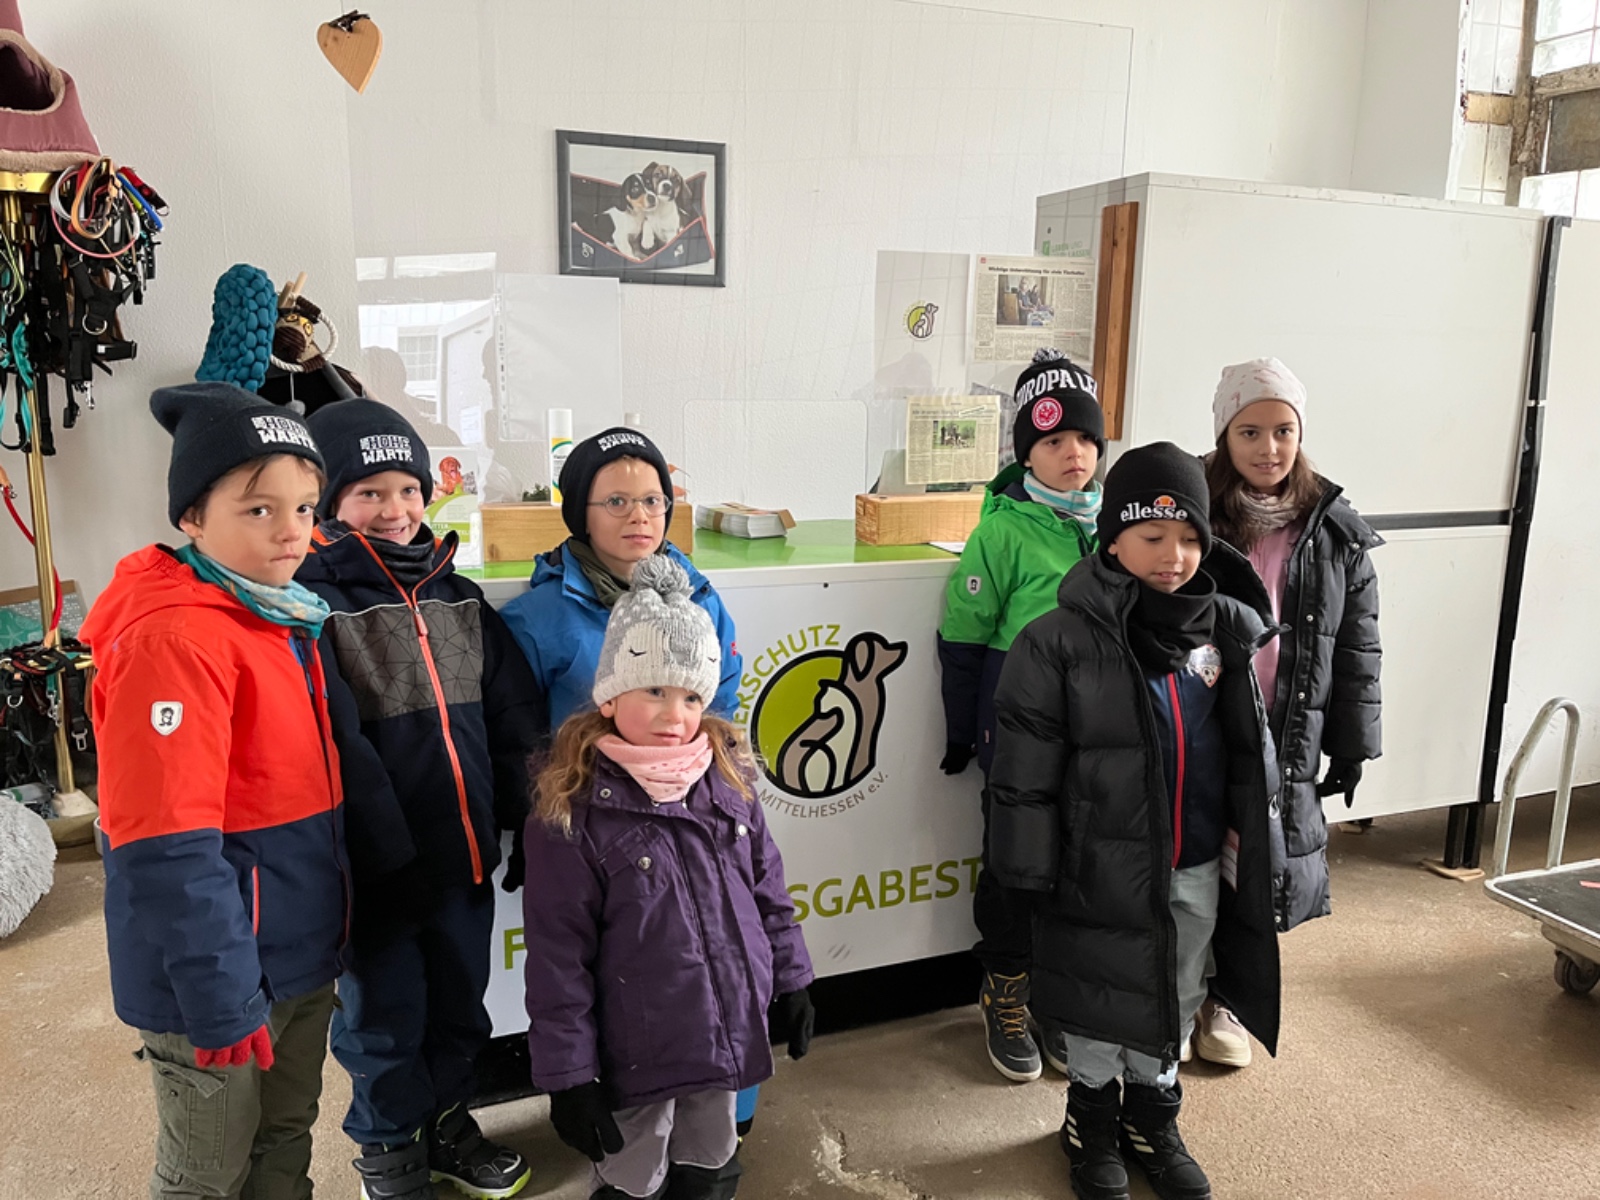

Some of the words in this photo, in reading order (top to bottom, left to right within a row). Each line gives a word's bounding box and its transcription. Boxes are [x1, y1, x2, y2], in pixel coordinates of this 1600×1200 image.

[1120, 502, 1188, 522] ellesse
[733, 624, 840, 732] ERSCHUTZ
[758, 789, 865, 818] MITTELHESSEN
[867, 771, 889, 793] e.V.
